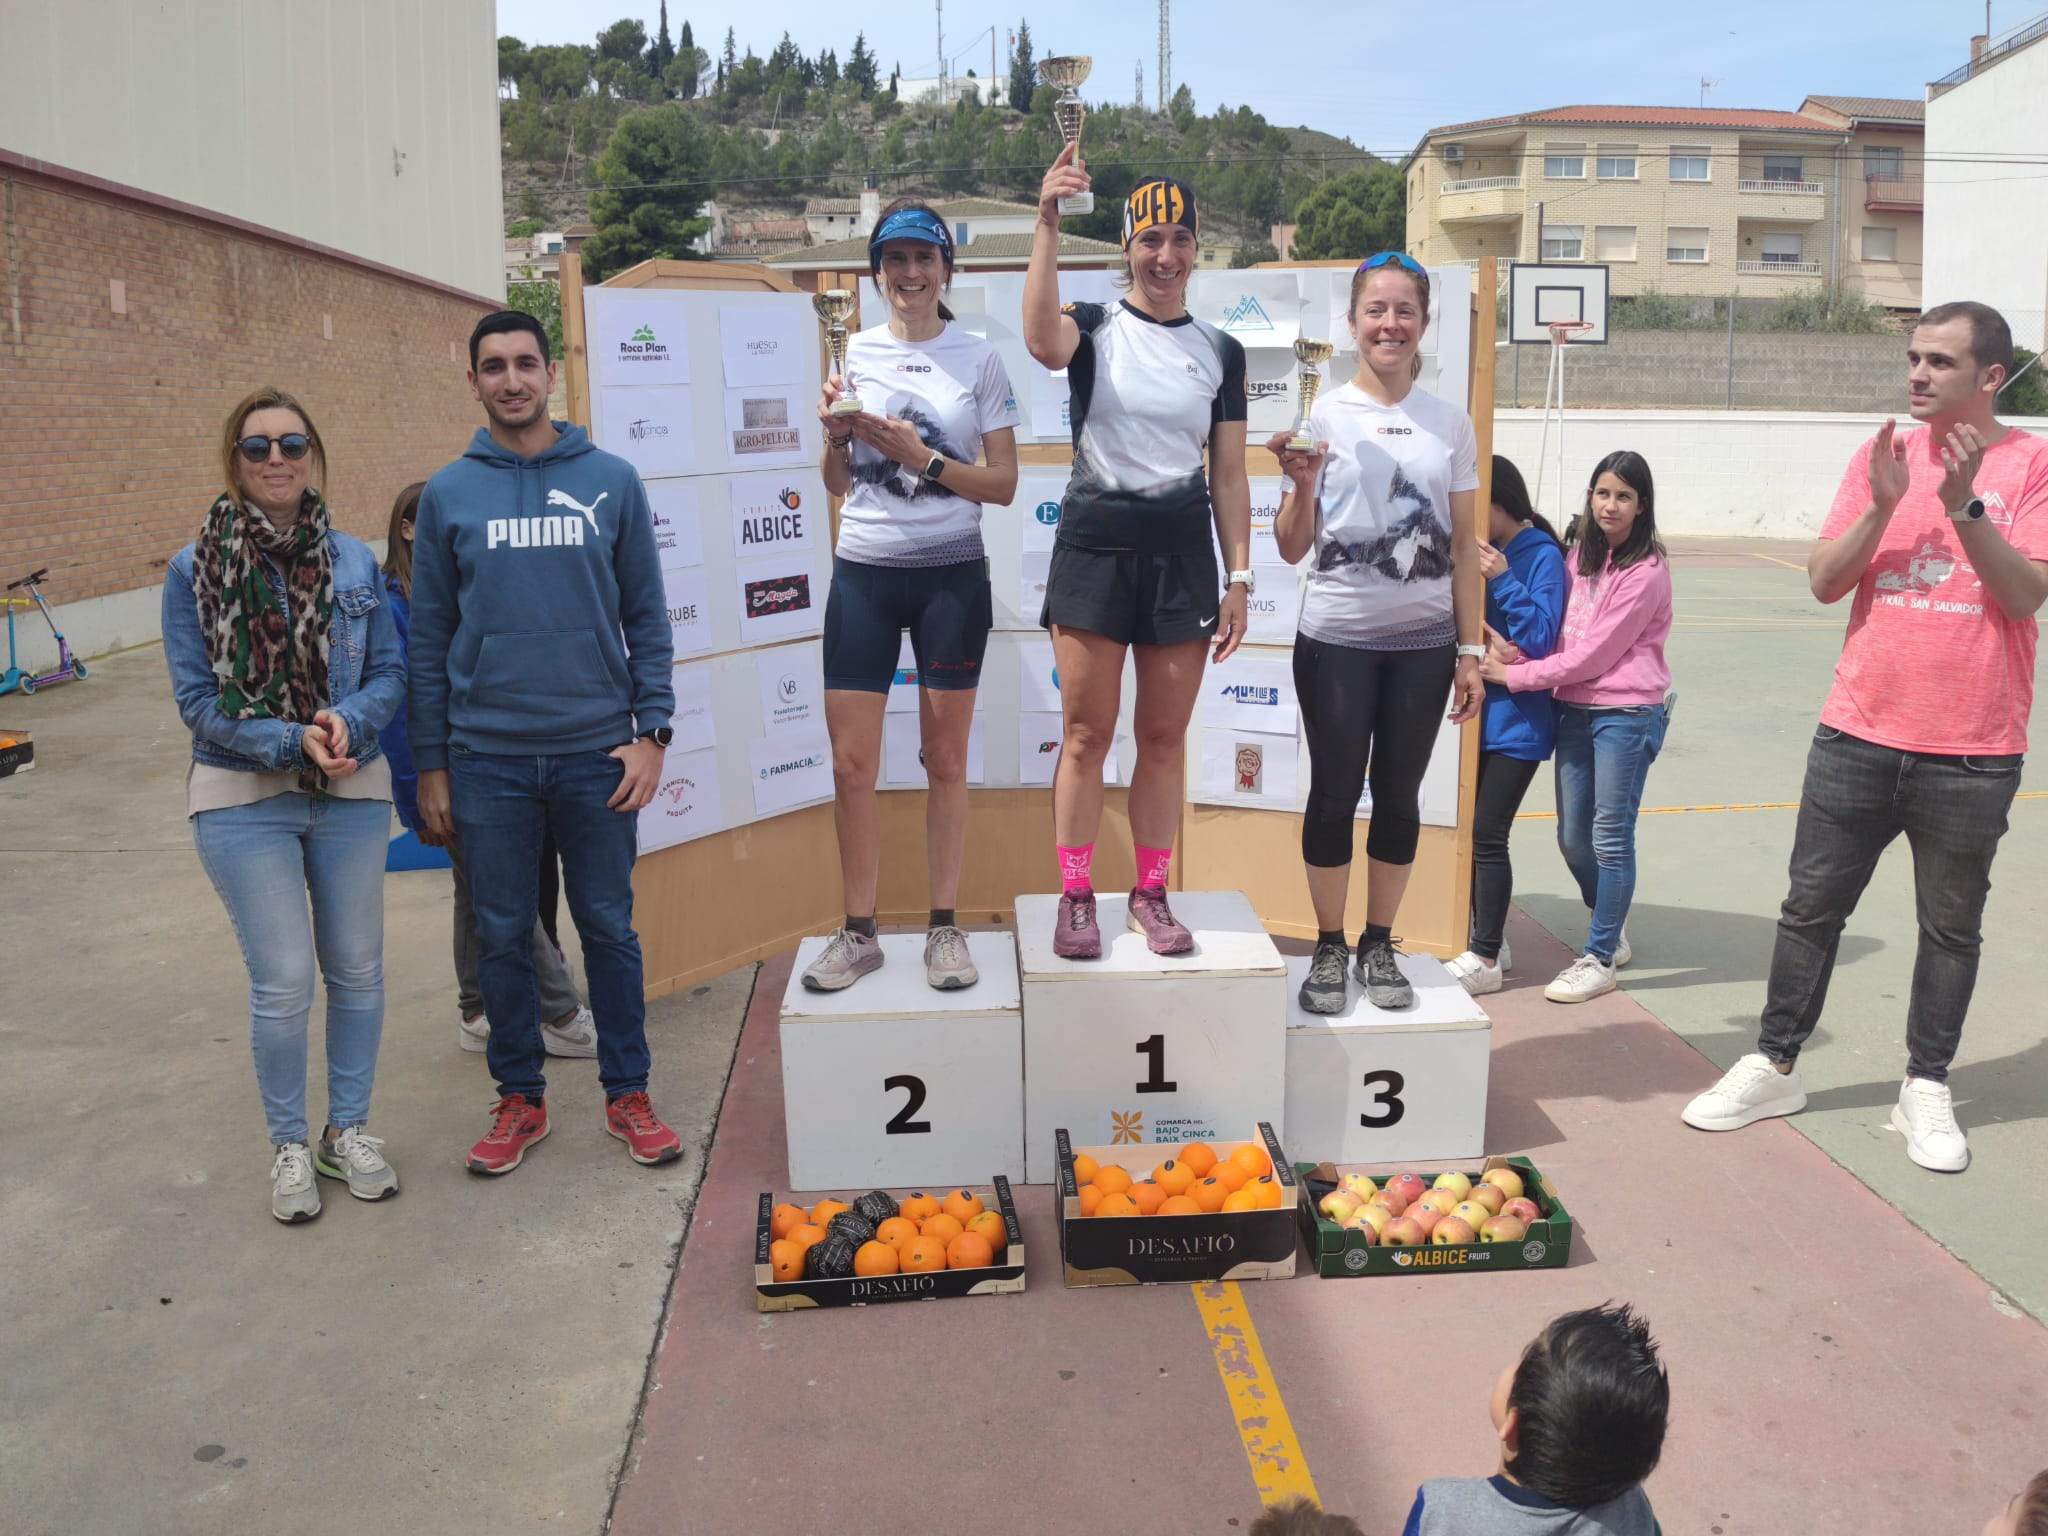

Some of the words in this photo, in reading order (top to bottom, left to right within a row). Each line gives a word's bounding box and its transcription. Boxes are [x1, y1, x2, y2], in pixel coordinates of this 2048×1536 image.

[620, 342, 643, 353] Roca
[645, 342, 667, 353] Plan
[1247, 382, 1288, 393] spesa
[1250, 503, 1281, 517] cada
[487, 516, 584, 550] PUMA
[742, 514, 804, 545] ALBICE
[1881, 593, 1906, 608] TRAIL
[1910, 597, 1931, 610] SAN
[1933, 600, 1984, 616] SALVADOR
[770, 757, 814, 777] FARMACIA
[1135, 1033, 1178, 1094] 1
[883, 1073, 932, 1135] 2
[1359, 1069, 1405, 1129] 3
[1155, 1126, 1180, 1135] BAJO
[1182, 1130, 1216, 1138] CINCA
[1155, 1136, 1180, 1144] BAIX
[1413, 1249, 1468, 1266] ALBICE
[1468, 1252, 1490, 1261] FRUITS
